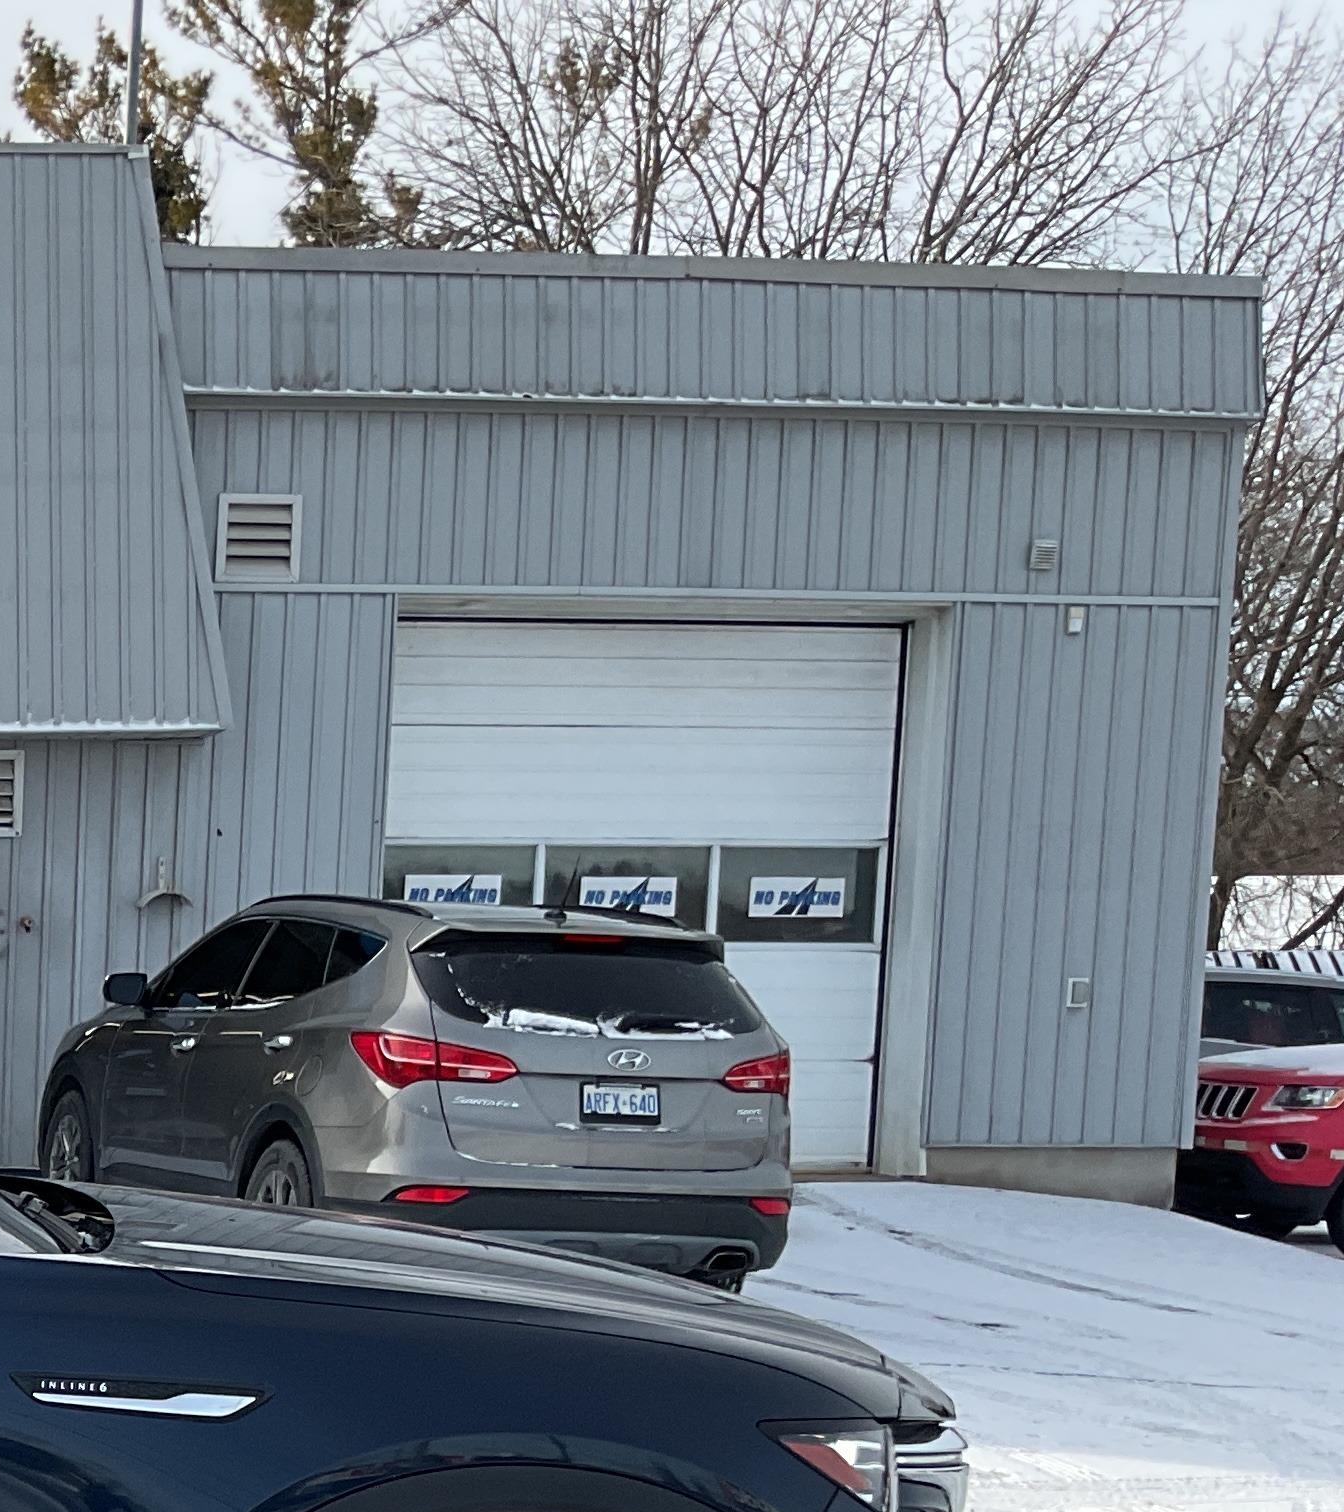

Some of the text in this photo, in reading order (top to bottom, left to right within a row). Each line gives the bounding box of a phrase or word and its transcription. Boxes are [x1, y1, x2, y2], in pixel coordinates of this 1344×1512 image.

[408, 887, 430, 902] NO
[583, 889, 606, 905] NO
[753, 890, 775, 906] NO
